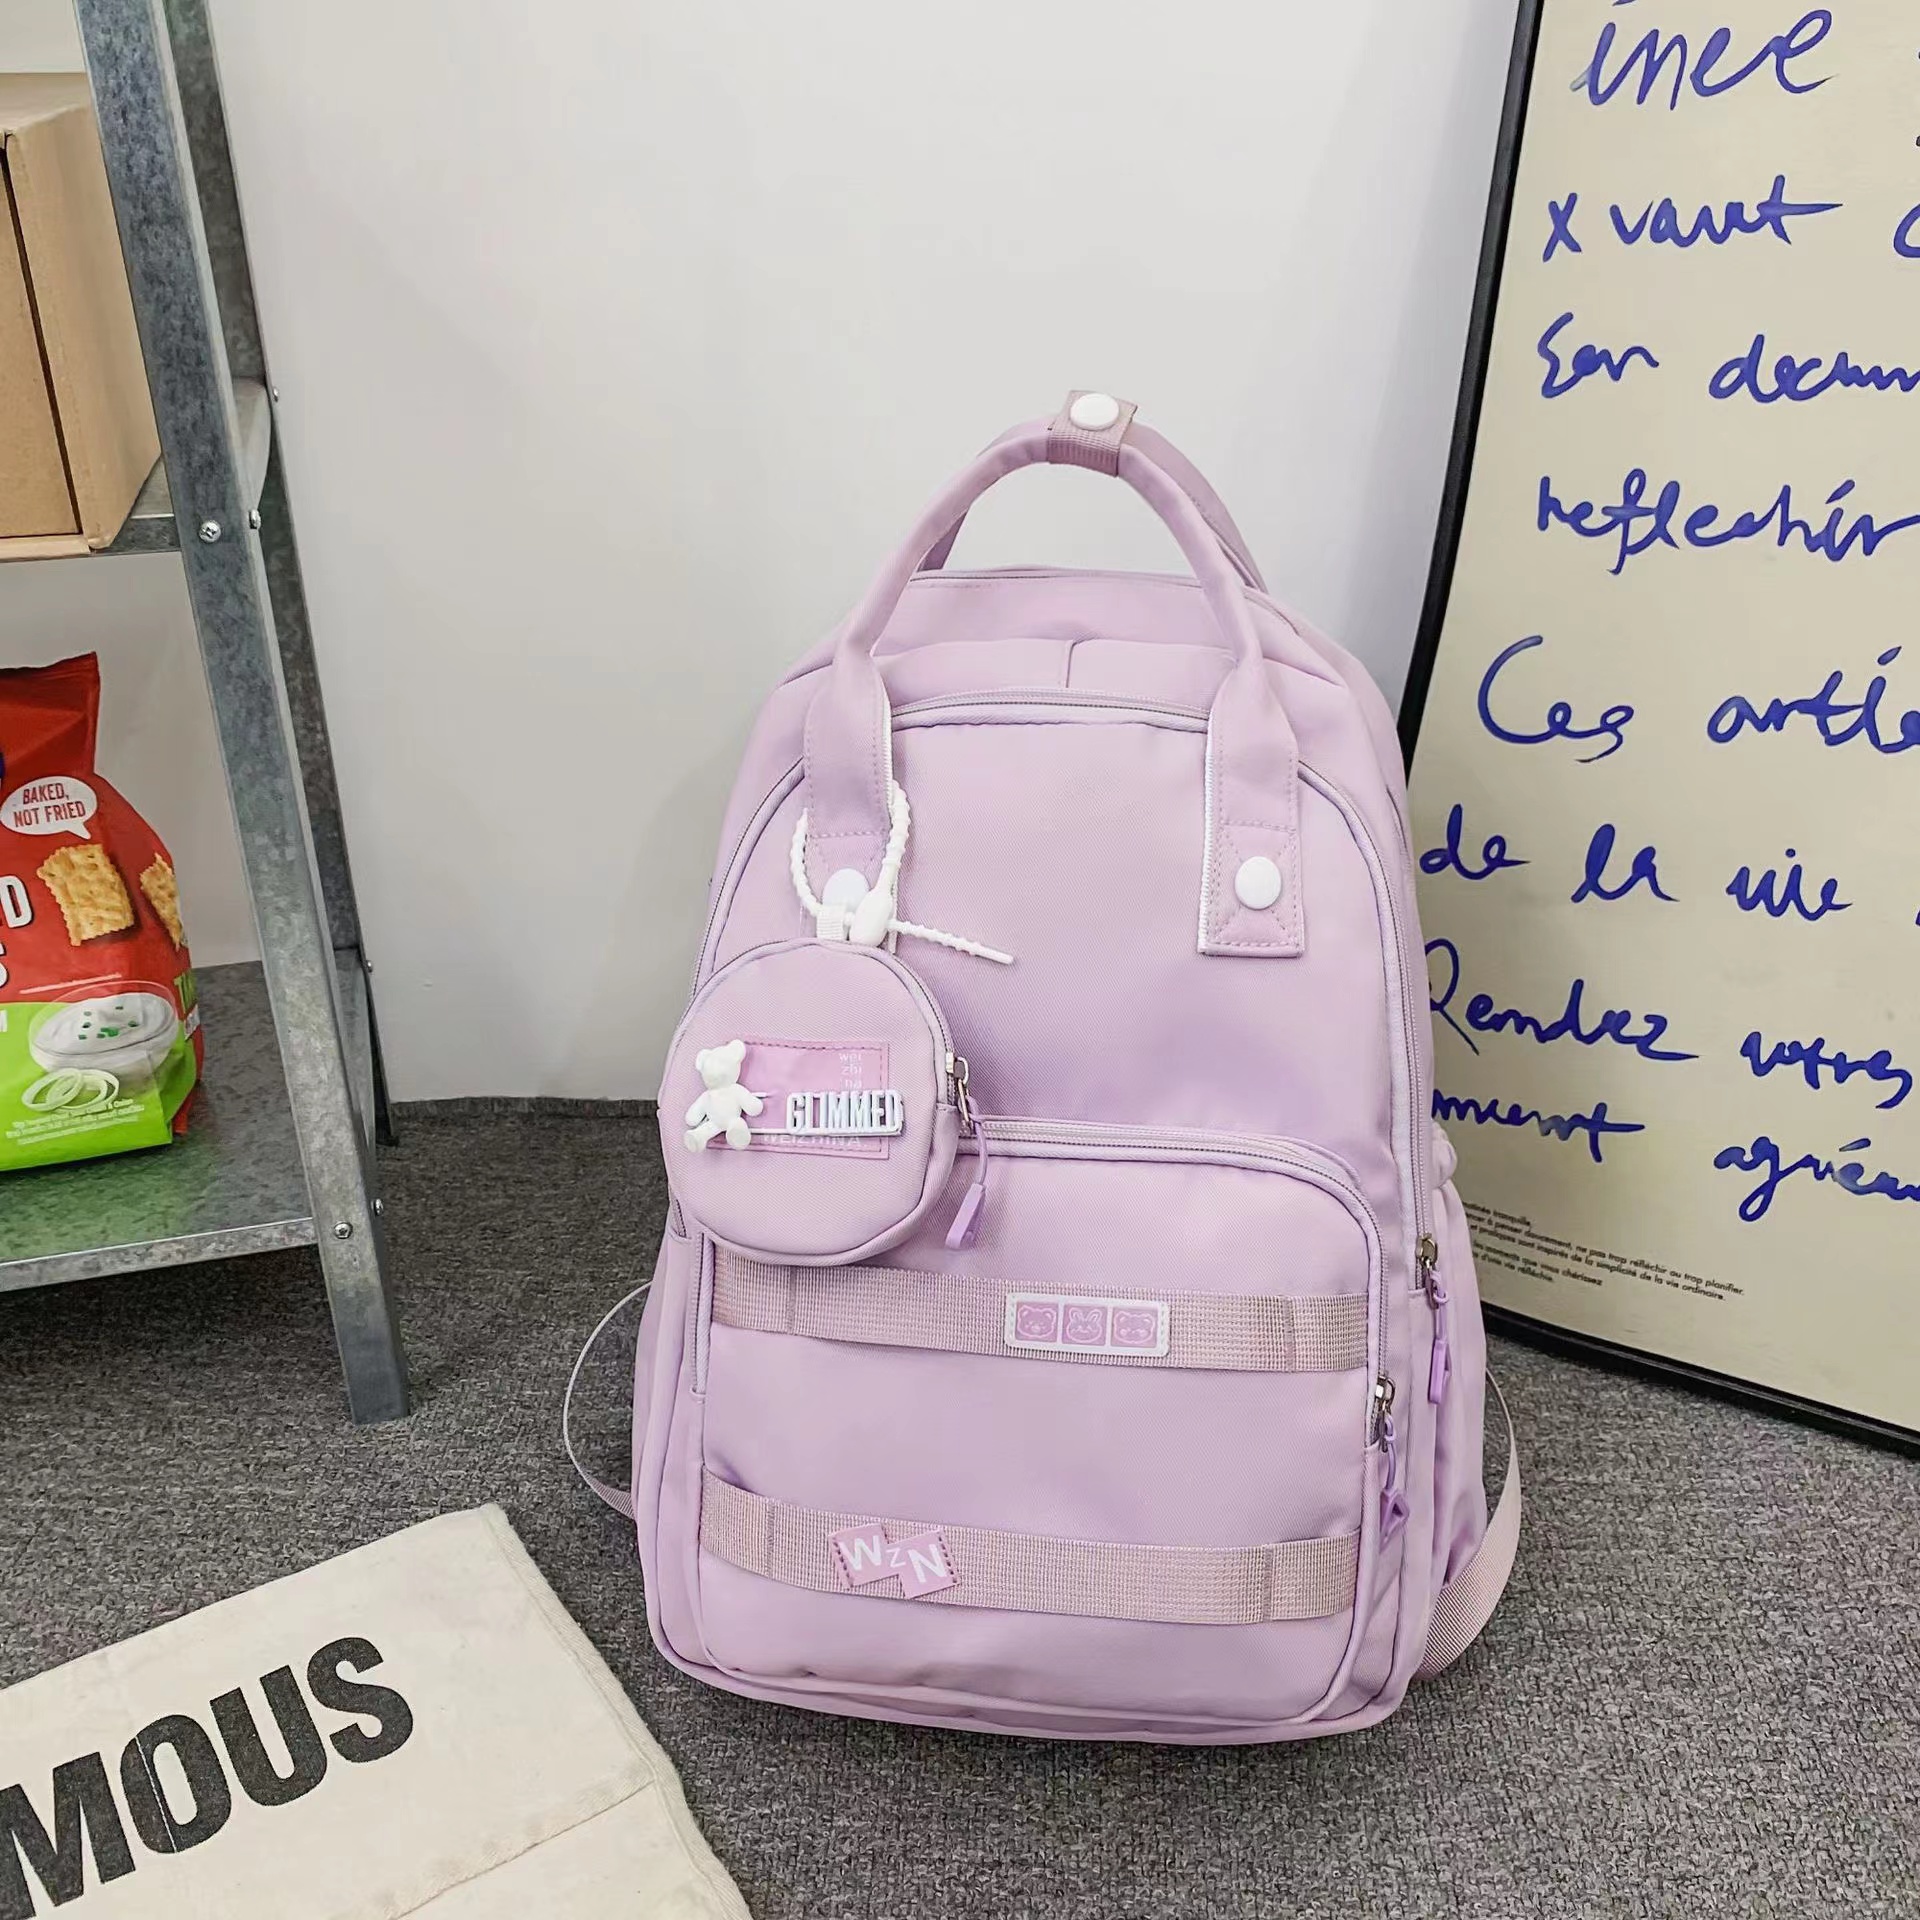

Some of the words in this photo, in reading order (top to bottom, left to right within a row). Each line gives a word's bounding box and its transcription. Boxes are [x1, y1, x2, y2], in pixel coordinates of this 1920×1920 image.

[22, 782, 70, 805] BAKED,
[13, 807, 40, 828] NOT
[44, 800, 87, 822] FRIED
[1419, 803, 1532, 880] de
[1608, 1253, 1627, 1265] trop
[1684, 1273, 1704, 1288] trop
[1639, 1271, 1652, 1281] de
[1654, 1274, 1664, 1285] la
[0, 1637, 413, 1920] MOUS
